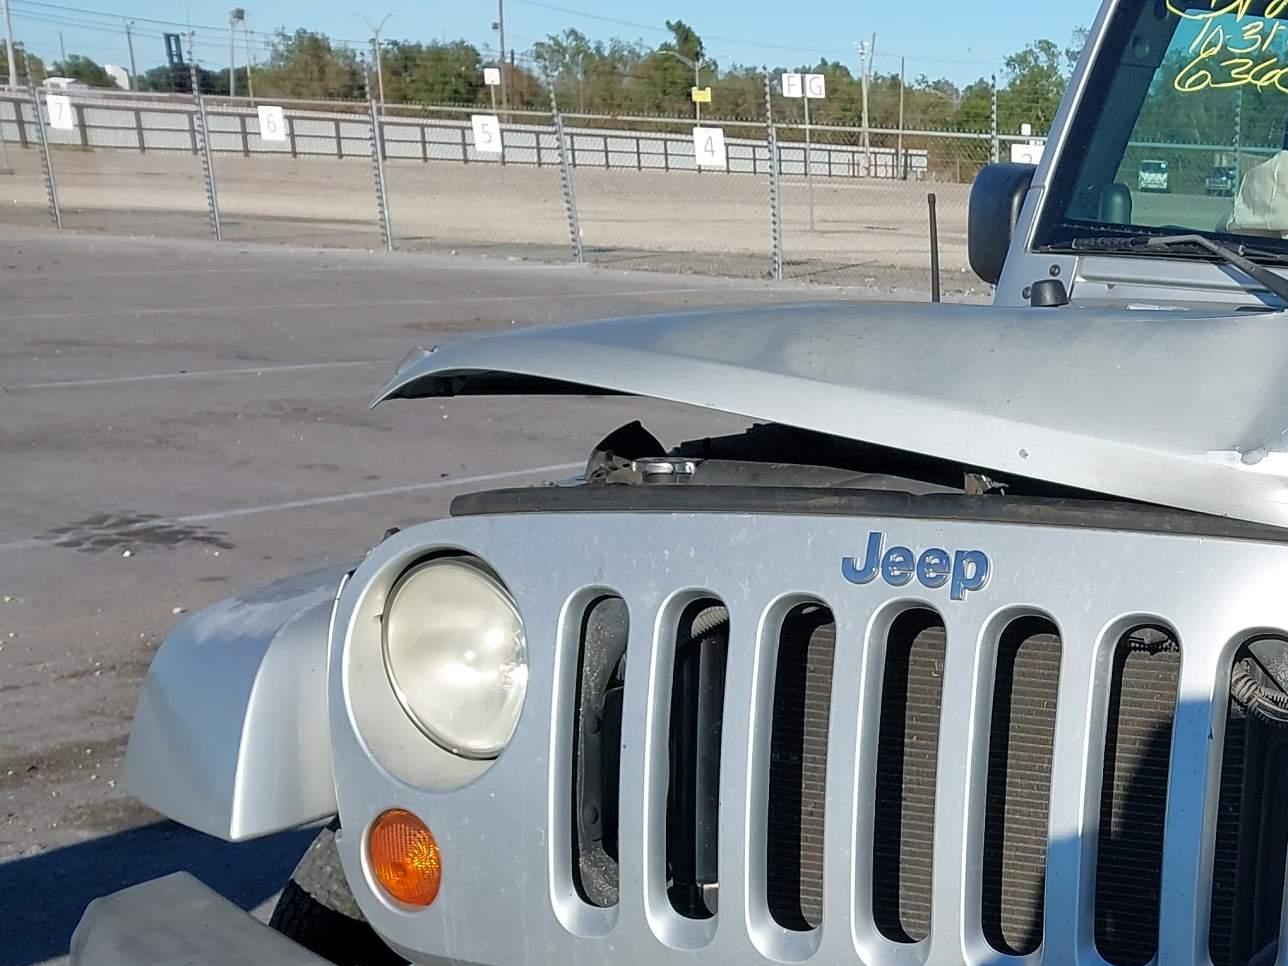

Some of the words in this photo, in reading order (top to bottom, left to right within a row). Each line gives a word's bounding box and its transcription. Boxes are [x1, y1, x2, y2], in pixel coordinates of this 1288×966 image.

[786, 75, 796, 95] F
[809, 76, 823, 97] G
[54, 102, 64, 121] 7
[266, 112, 277, 133] 6
[481, 123, 493, 144] 5
[703, 135, 716, 158] 4
[842, 531, 992, 600] Jeep
